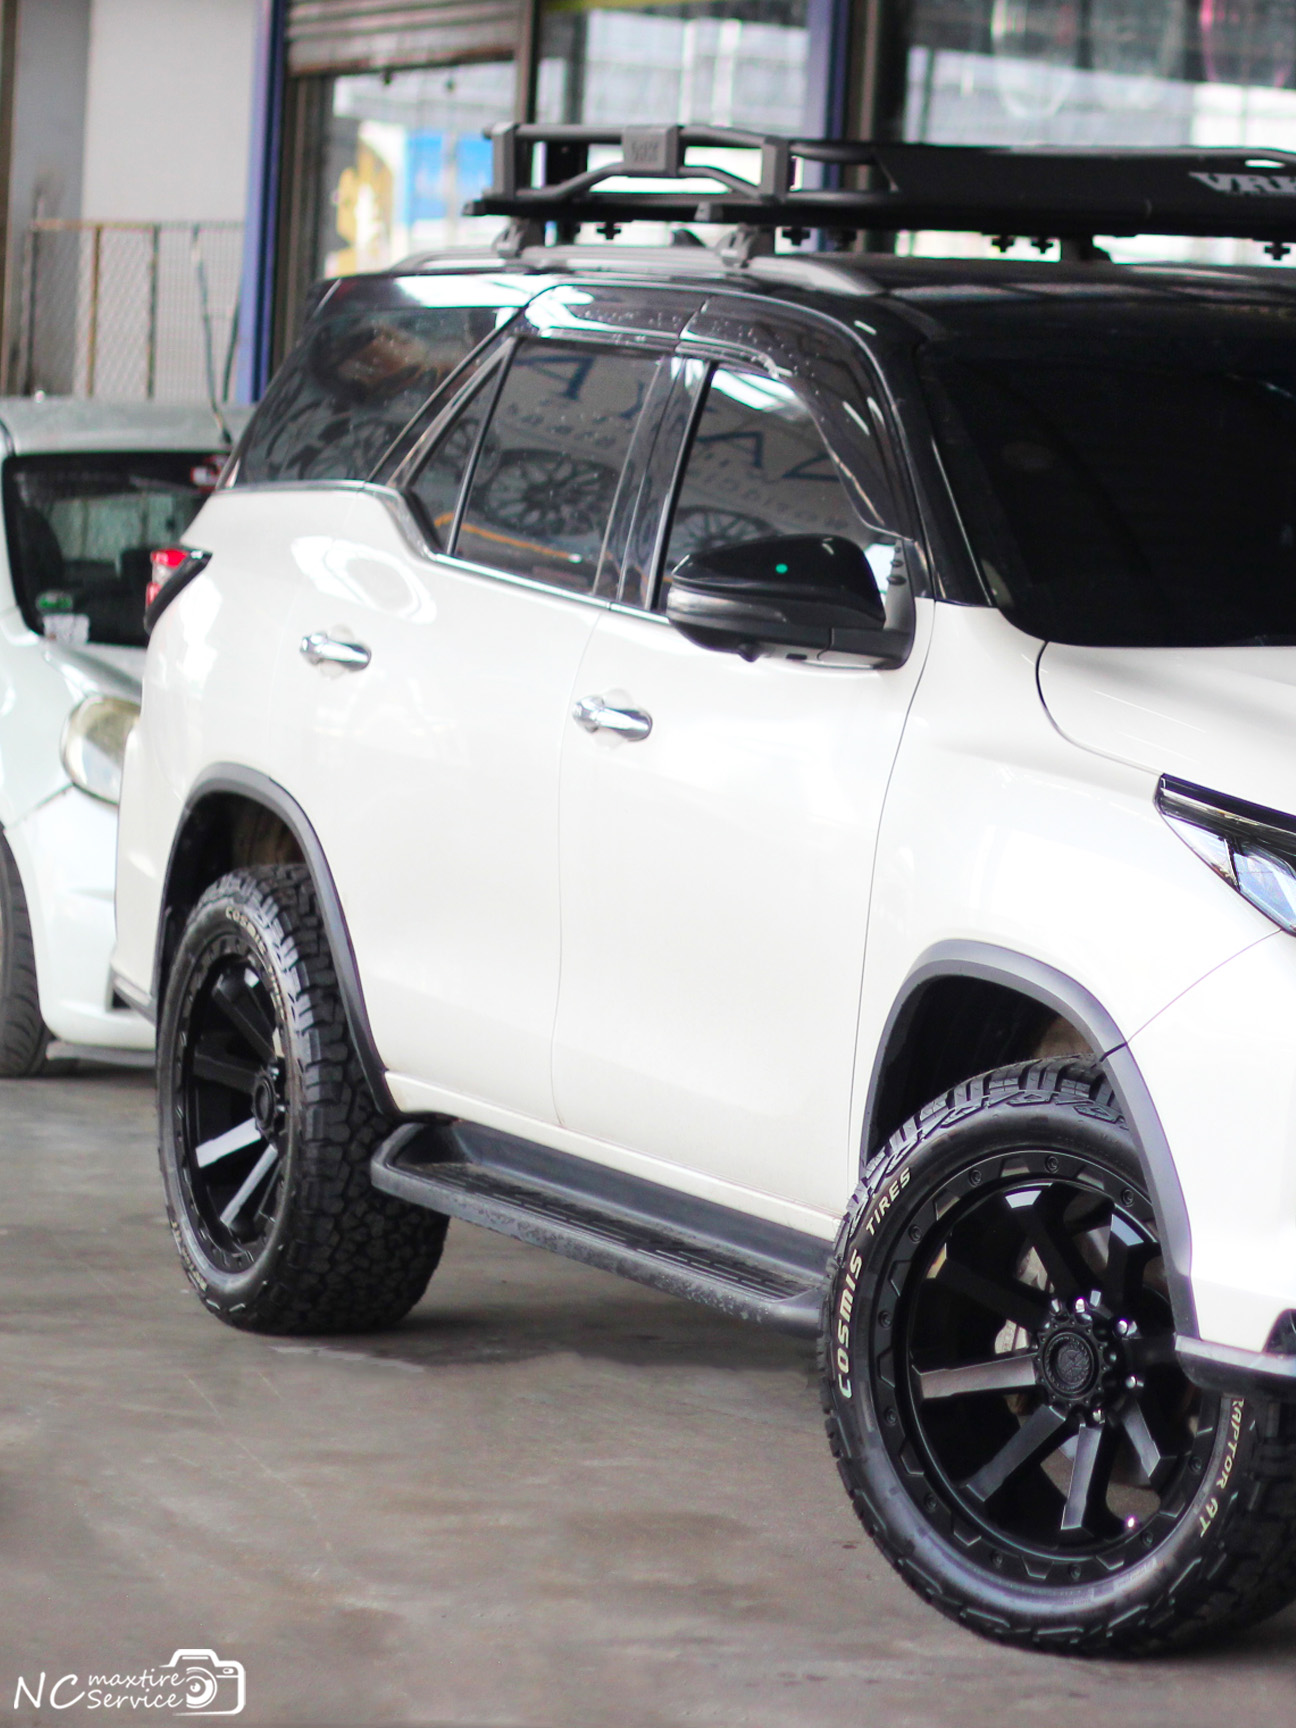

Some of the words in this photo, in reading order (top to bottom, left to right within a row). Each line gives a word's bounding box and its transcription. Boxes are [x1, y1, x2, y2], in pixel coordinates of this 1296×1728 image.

[837, 1248, 863, 1399] COSMIS
[865, 1167, 911, 1236] TIRES
[1200, 1498, 1219, 1538] AT
